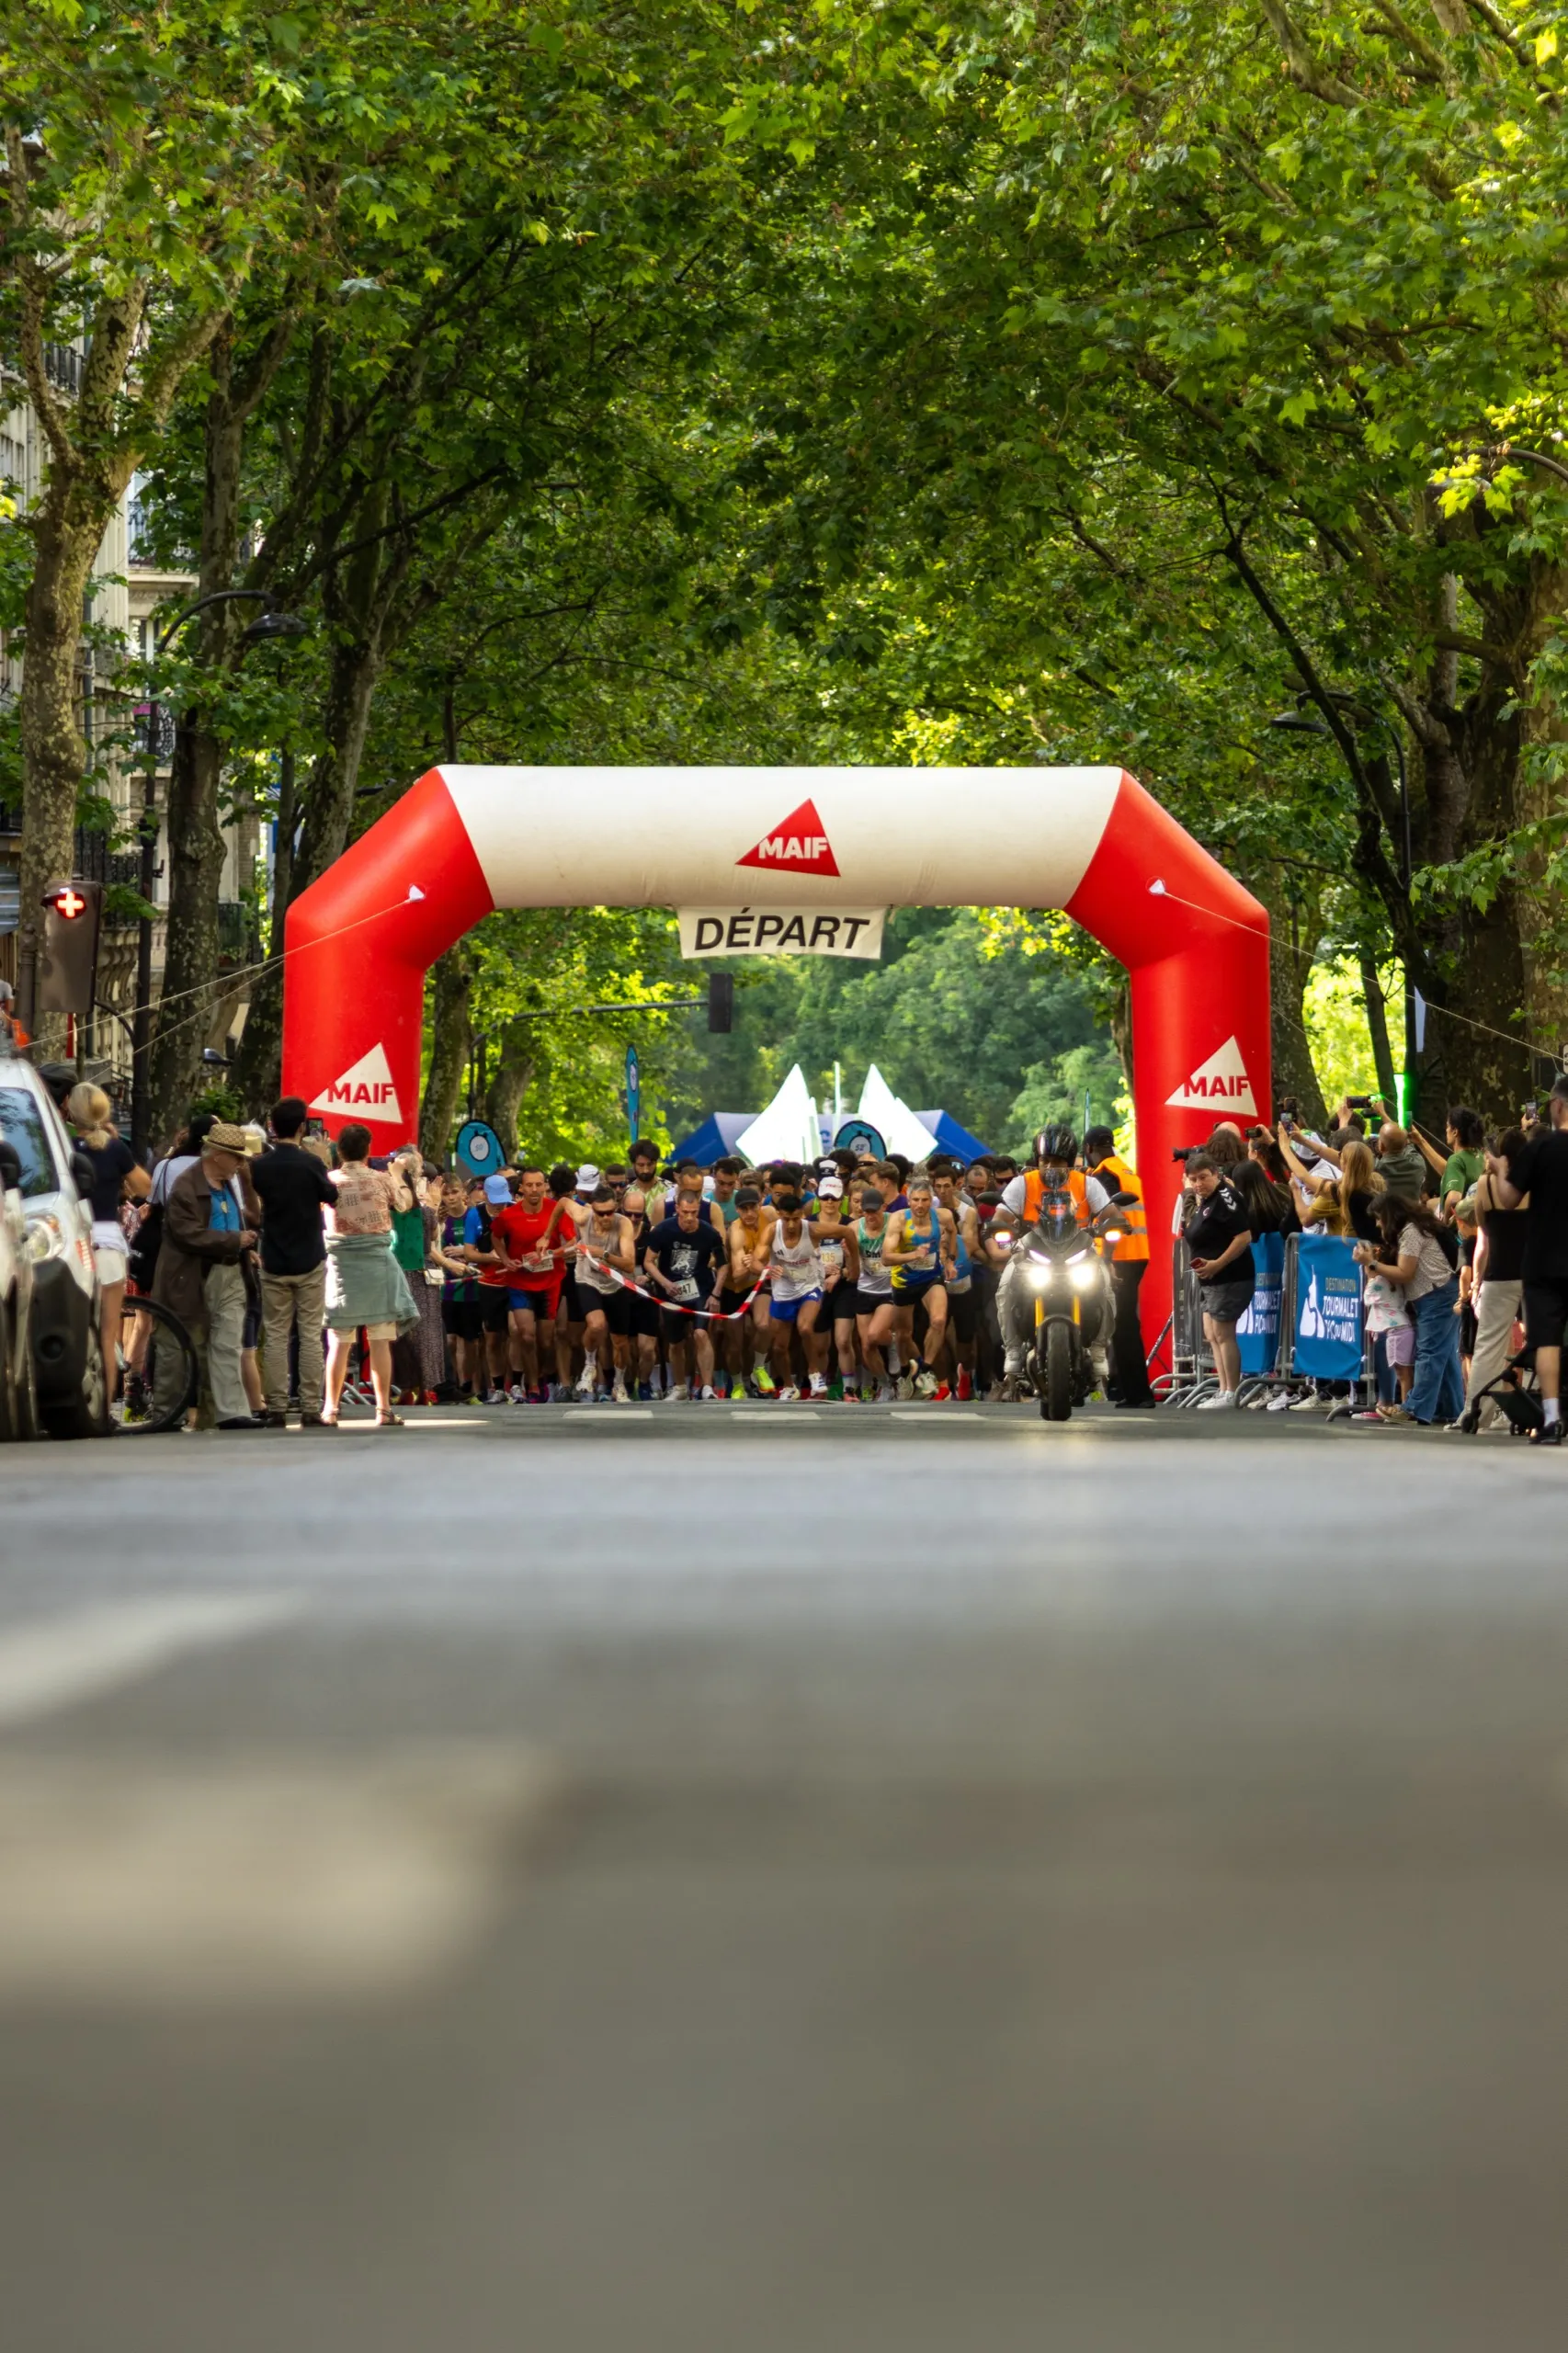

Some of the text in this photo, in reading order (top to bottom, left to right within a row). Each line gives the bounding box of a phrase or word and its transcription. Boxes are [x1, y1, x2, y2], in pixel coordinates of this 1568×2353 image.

[757, 836, 828, 859] MAIF
[694, 906, 870, 951] DÉPART
[327, 1082, 396, 1104] MAIF
[1182, 1075, 1250, 1098] MAIF
[1325, 1277, 1357, 1293] DESTINATION
[1322, 1296, 1358, 1318] TOURMALET
